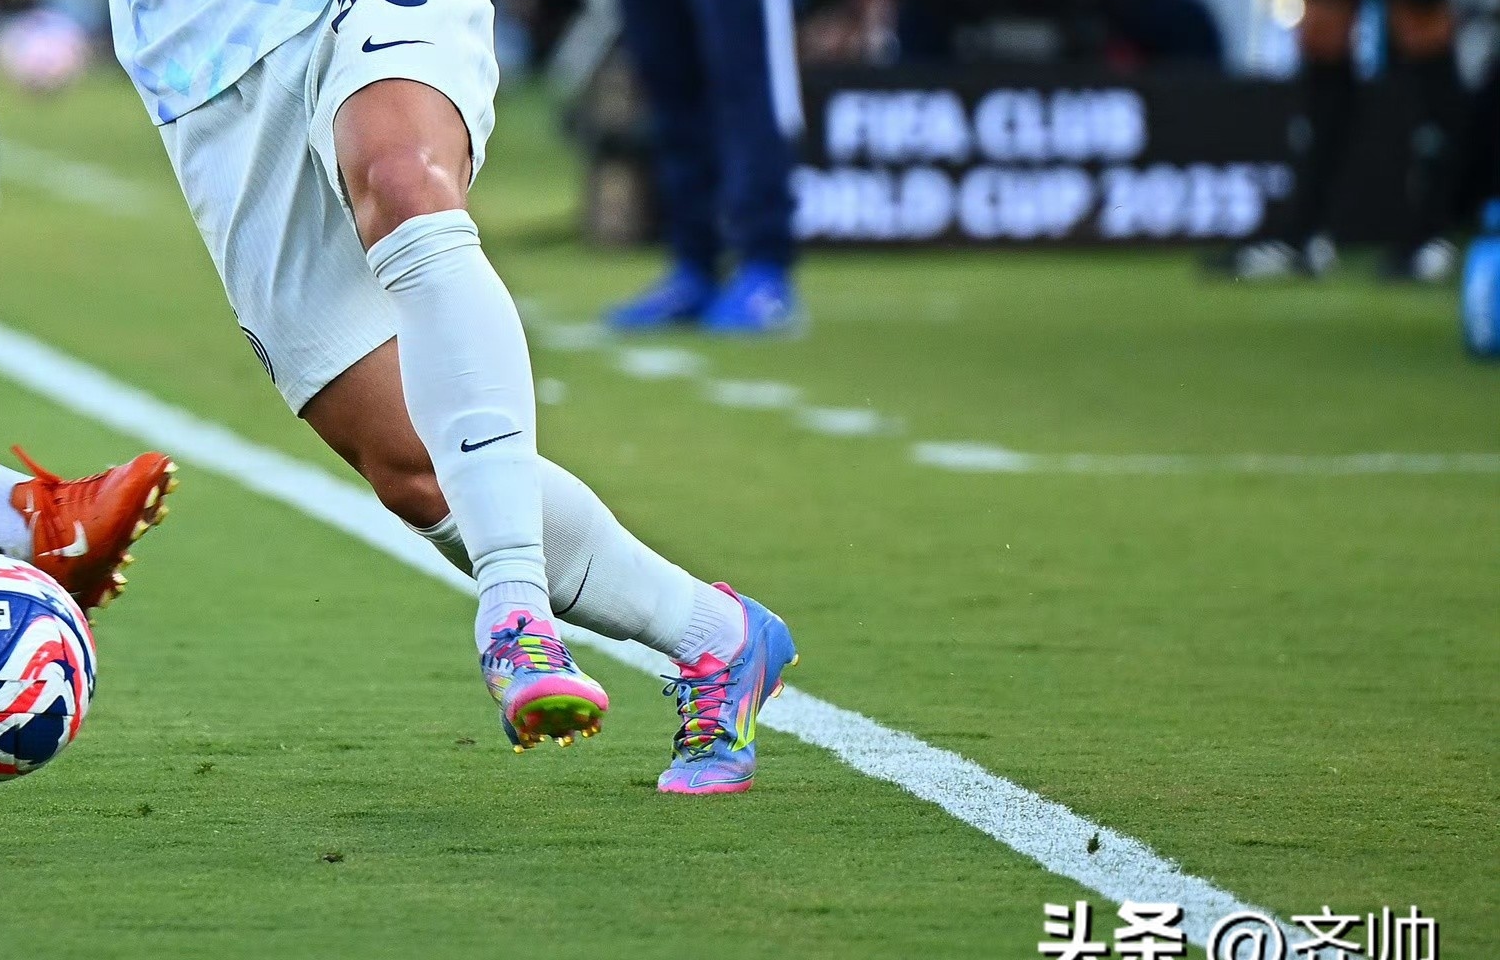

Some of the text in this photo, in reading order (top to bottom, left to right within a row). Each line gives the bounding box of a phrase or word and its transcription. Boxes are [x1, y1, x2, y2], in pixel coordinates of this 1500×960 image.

[826, 88, 1147, 162] FIFA CLUB
[957, 162, 1098, 238] CUP
